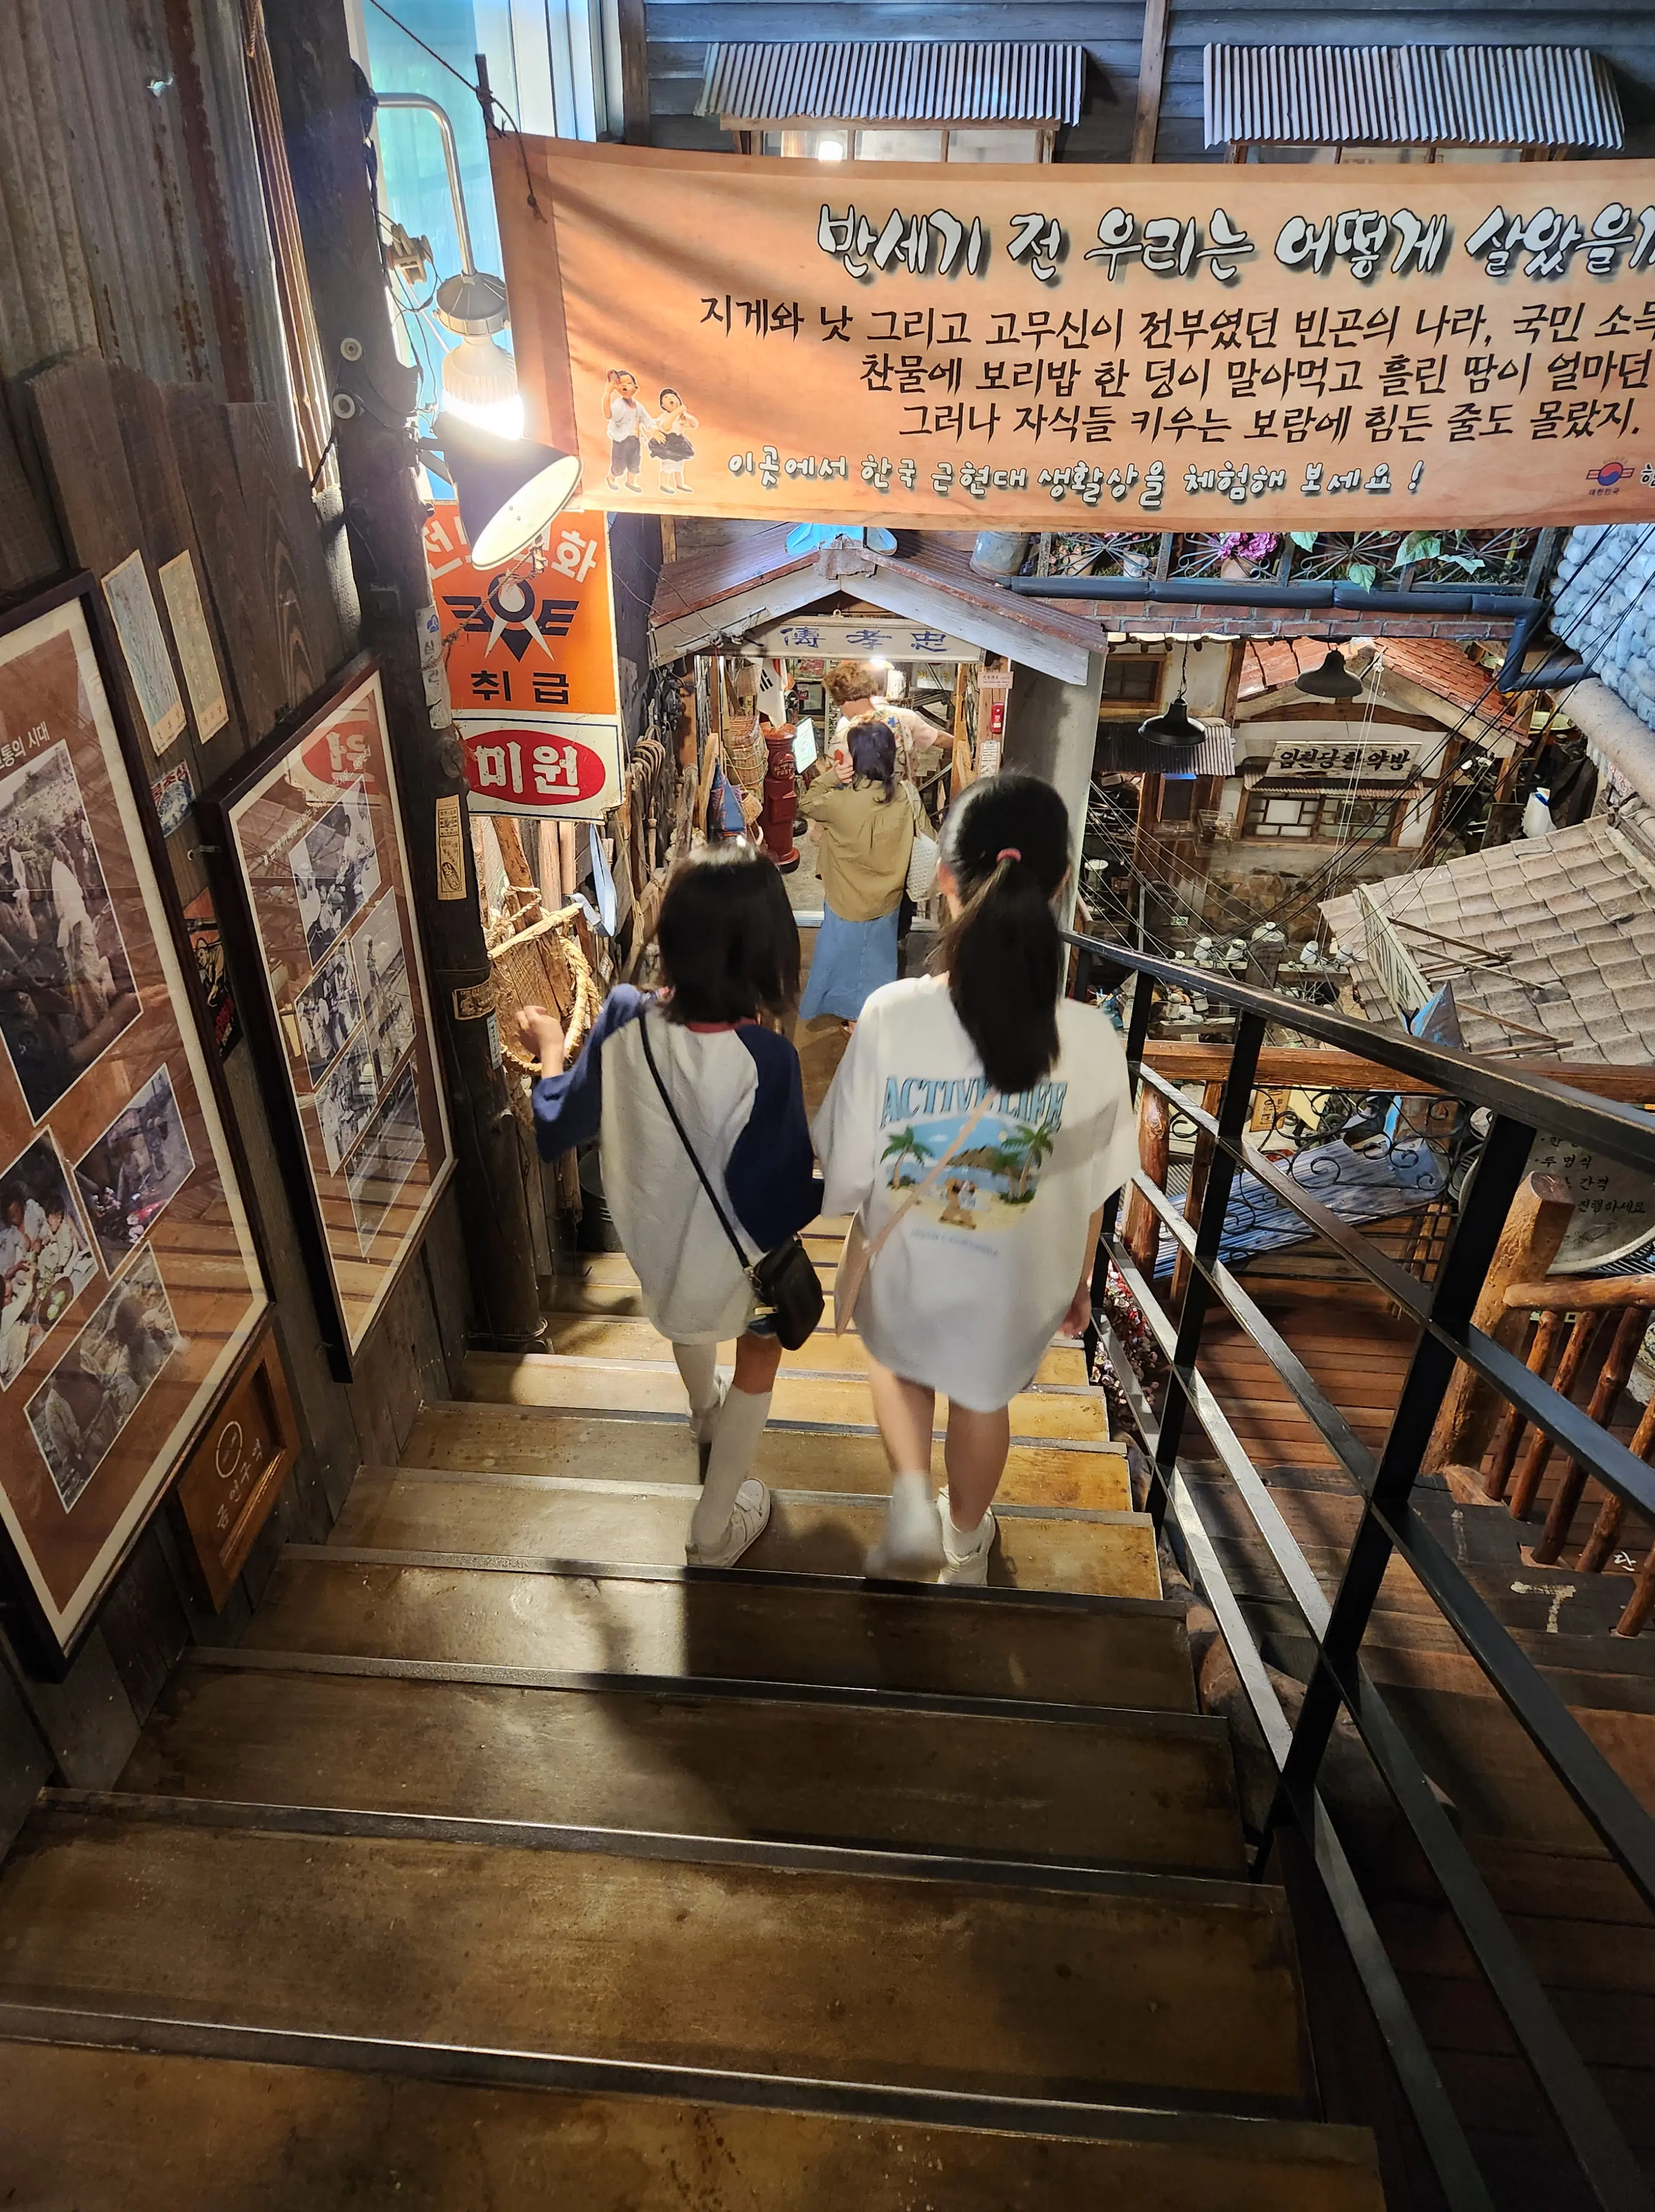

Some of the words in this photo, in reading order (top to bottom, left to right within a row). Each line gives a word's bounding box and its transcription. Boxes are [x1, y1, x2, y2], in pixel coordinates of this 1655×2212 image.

[817, 204, 981, 278] 반세기
[1006, 212, 1062, 281] 전
[1085, 207, 1254, 281] 우리는
[1276, 207, 1448, 279] 어떻게
[701, 295, 805, 340] 지게와
[820, 305, 853, 342] 낫
[867, 308, 971, 349] 그리고
[986, 309, 1123, 351] 고무신이
[1139, 308, 1278, 351] 전부였던
[1296, 306, 1400, 348] 빈곤의
[1416, 305, 1491, 347] 나라,
[1514, 302, 1585, 345] 국민
[860, 353, 962, 395] 찬물에
[976, 359, 1081, 397] 보리밥
[1095, 359, 1130, 397] 한
[1146, 359, 1210, 400] 덩이
[1229, 357, 1363, 399] 말아먹고
[1379, 354, 1447, 397] 흘린
[1465, 353, 1532, 394] 땀이
[1548, 349, 1652, 392] 얼마던
[899, 403, 1001, 443] 그러나
[1013, 404, 1116, 442] 자식들
[1131, 406, 1231, 444] 키우는
[1244, 406, 1352, 444] 보람에
[1366, 405, 1433, 442] 힘든
[1448, 403, 1513, 442] 줄도
[1531, 398, 1639, 440] 몰랐지.
[728, 445, 846, 487] 이곳에서
[860, 454, 917, 489] 한국
[930, 461, 1027, 495] 근현대
[1037, 460, 1164, 507] 생활상을
[1184, 462, 1285, 501] 체험해
[1300, 463, 1391, 493] 보세요
[1589, 487, 1620, 496] 대한민국
[470, 670, 570, 705] 취급
[473, 741, 580, 796] 미원
